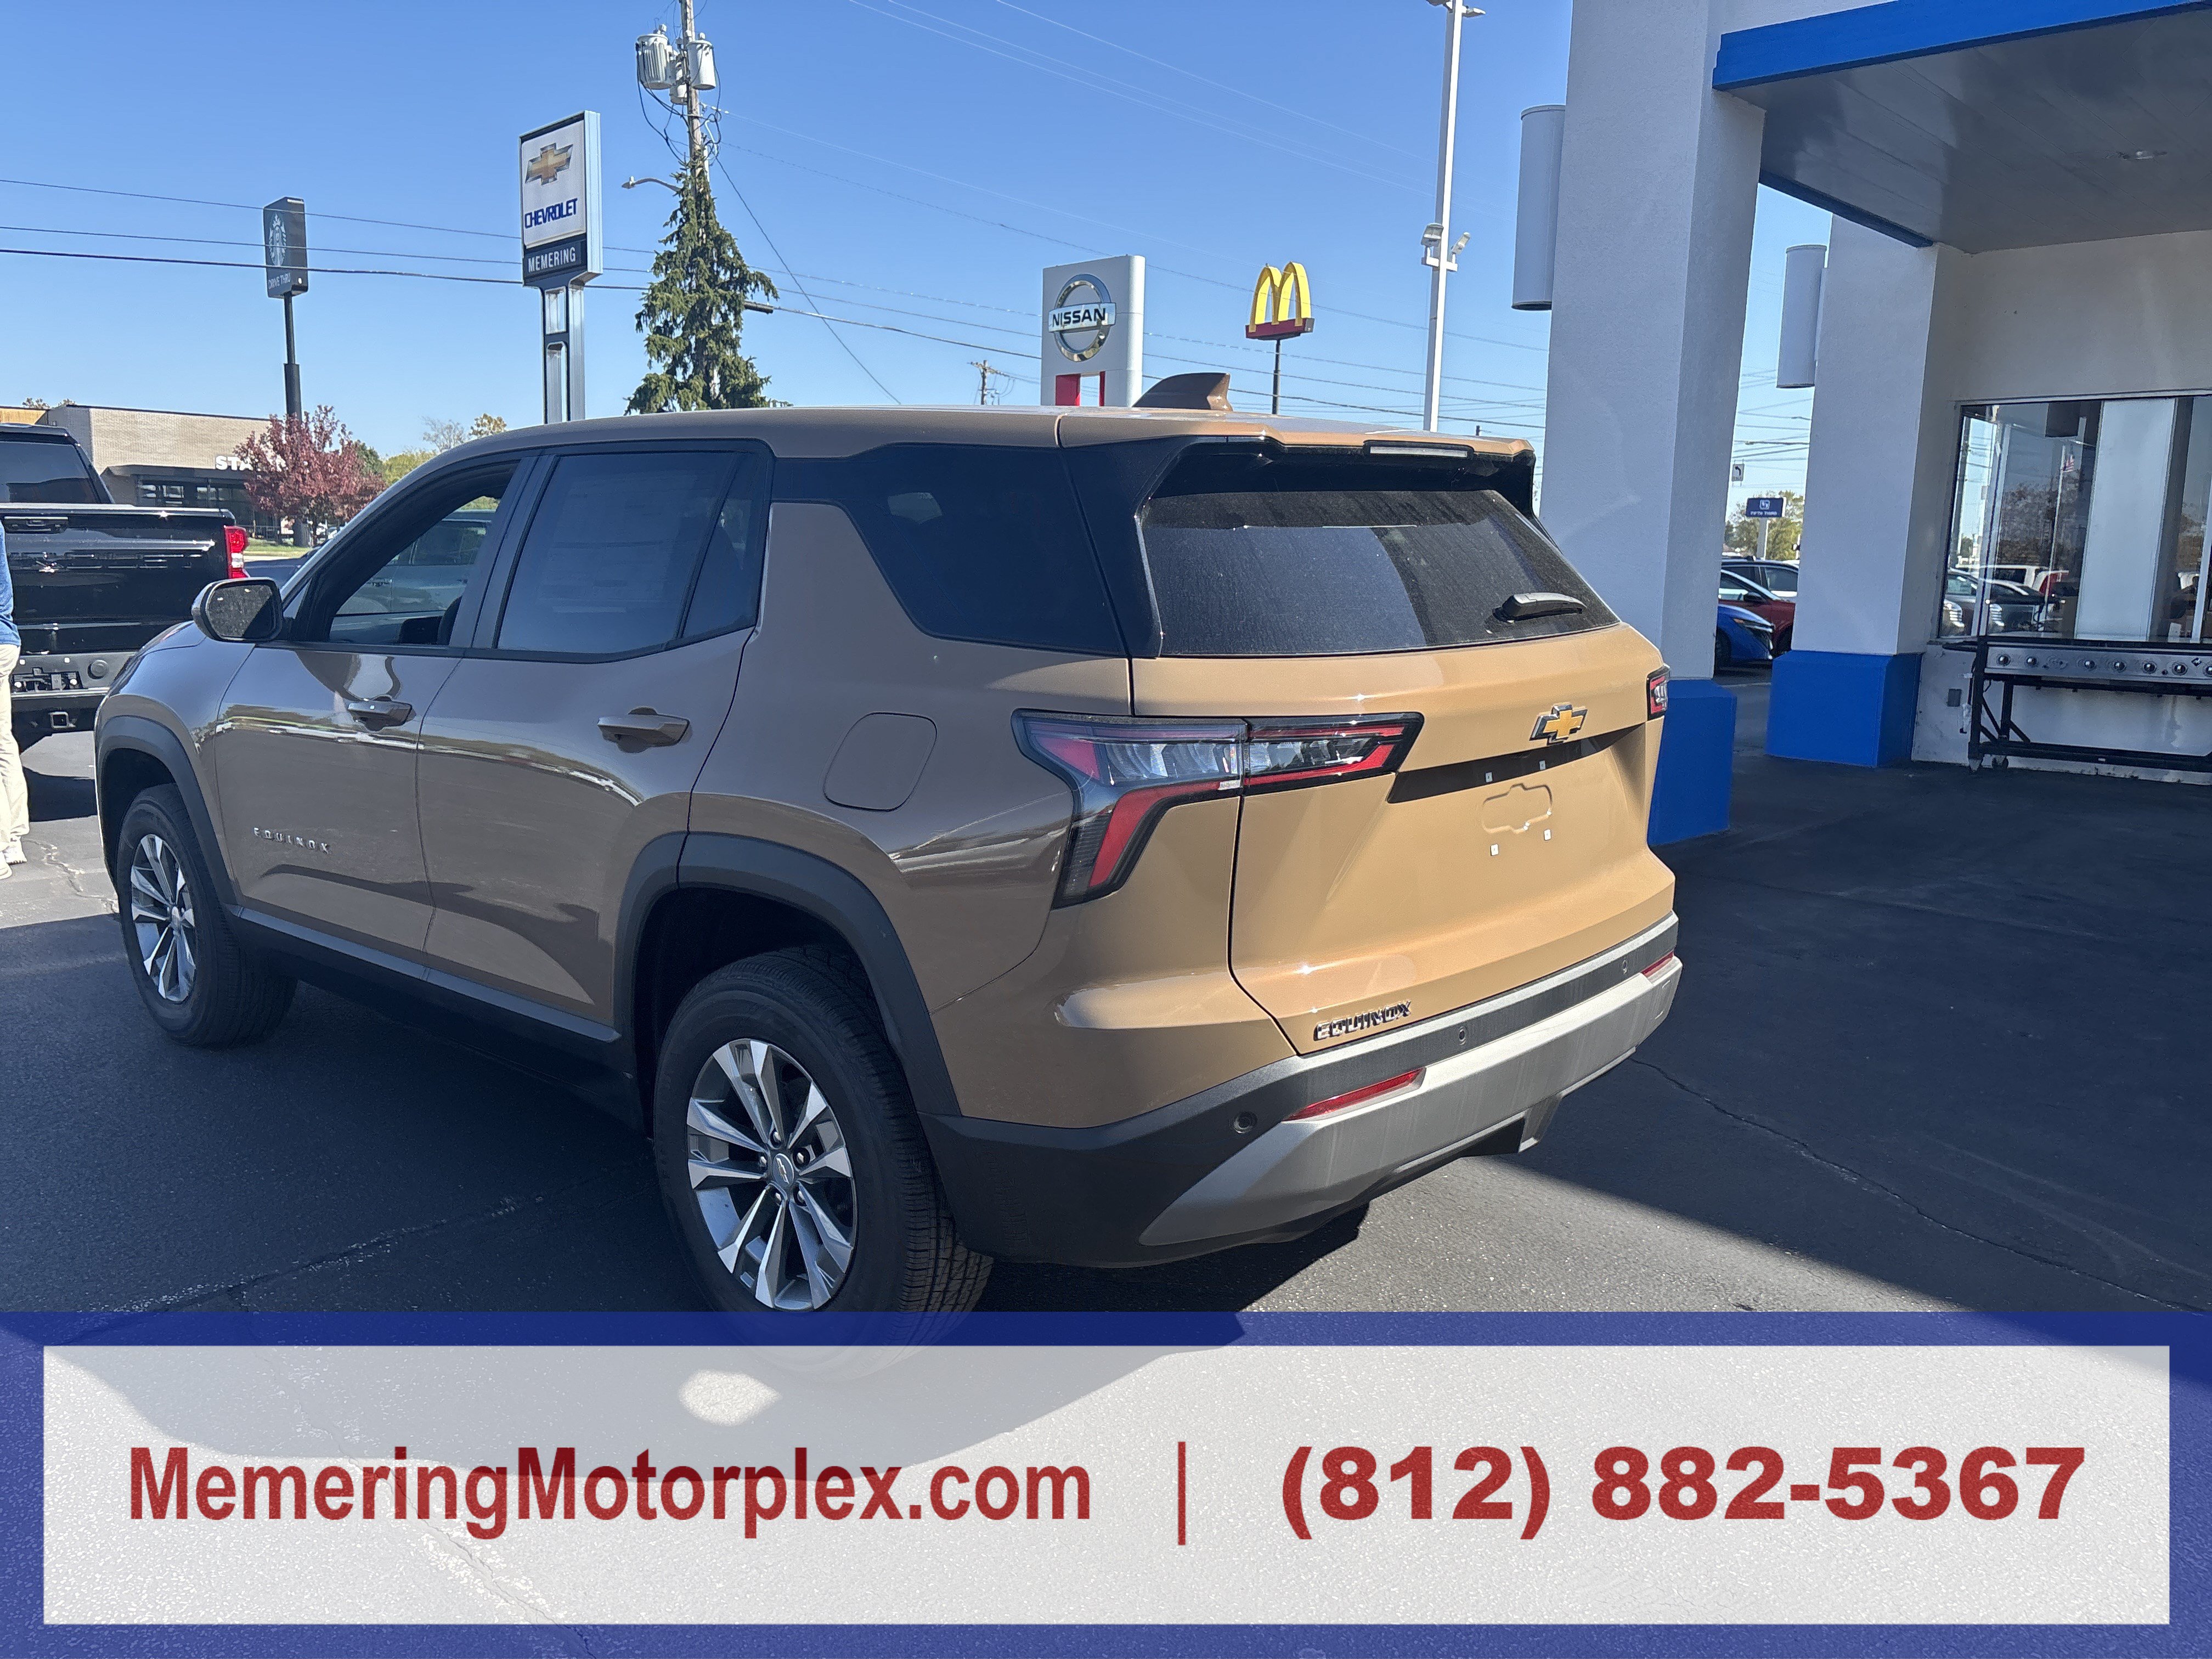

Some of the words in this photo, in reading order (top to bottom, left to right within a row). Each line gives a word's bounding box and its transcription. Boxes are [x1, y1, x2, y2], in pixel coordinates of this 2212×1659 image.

[525, 198, 578, 229] CHEVROLET
[528, 247, 576, 272] MEMERING
[1052, 308, 1106, 327] NISSAN
[253, 827, 331, 855] EQUINOX
[1313, 1000, 1412, 1041] EQUINOX
